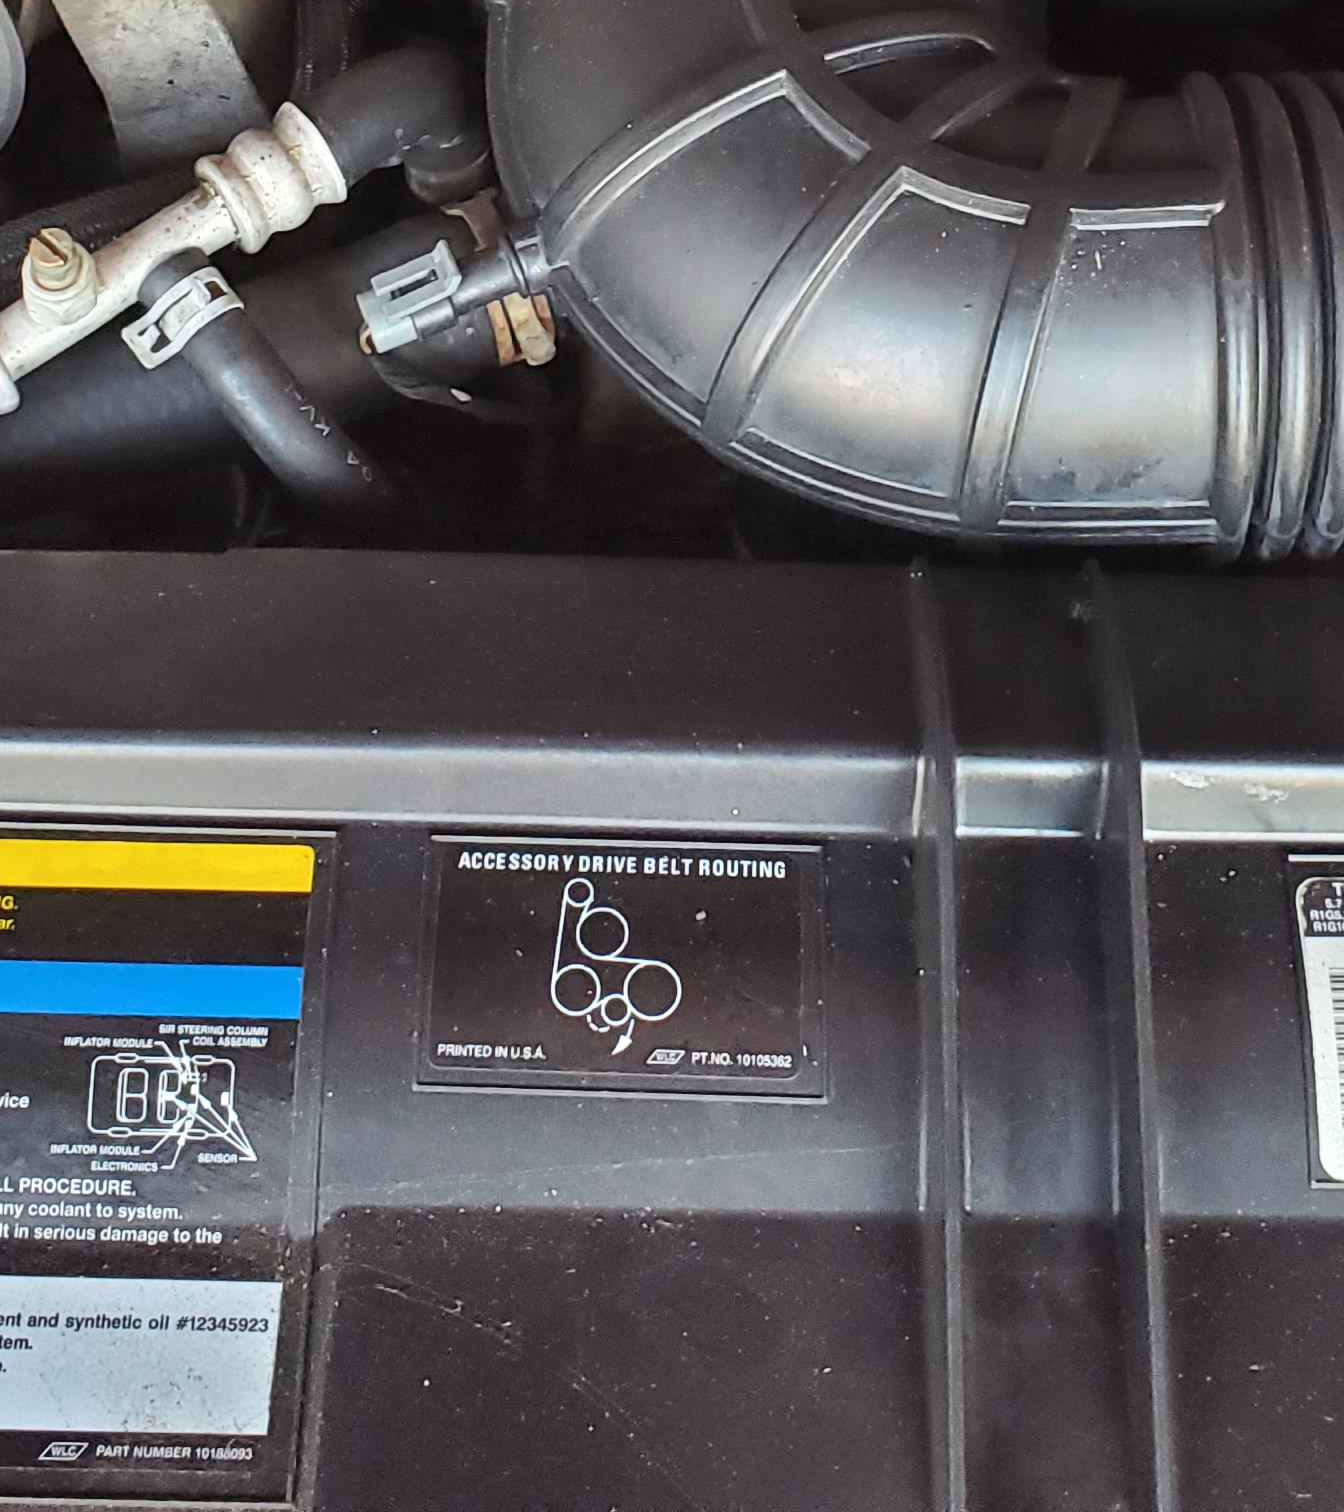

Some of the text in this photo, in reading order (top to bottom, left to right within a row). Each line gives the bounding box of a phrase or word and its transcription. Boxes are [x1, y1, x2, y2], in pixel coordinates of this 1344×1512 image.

[459, 851, 786, 878] ACCESSORY DRIVE BELT ROUTING
[437, 1043, 492, 1058] PRINTED
[495, 1046, 508, 1058] IN
[19, 1177, 136, 1196] PROCEDURE.
[95, 1444, 130, 1457] PART
[133, 1446, 192, 1459] NUMBER
